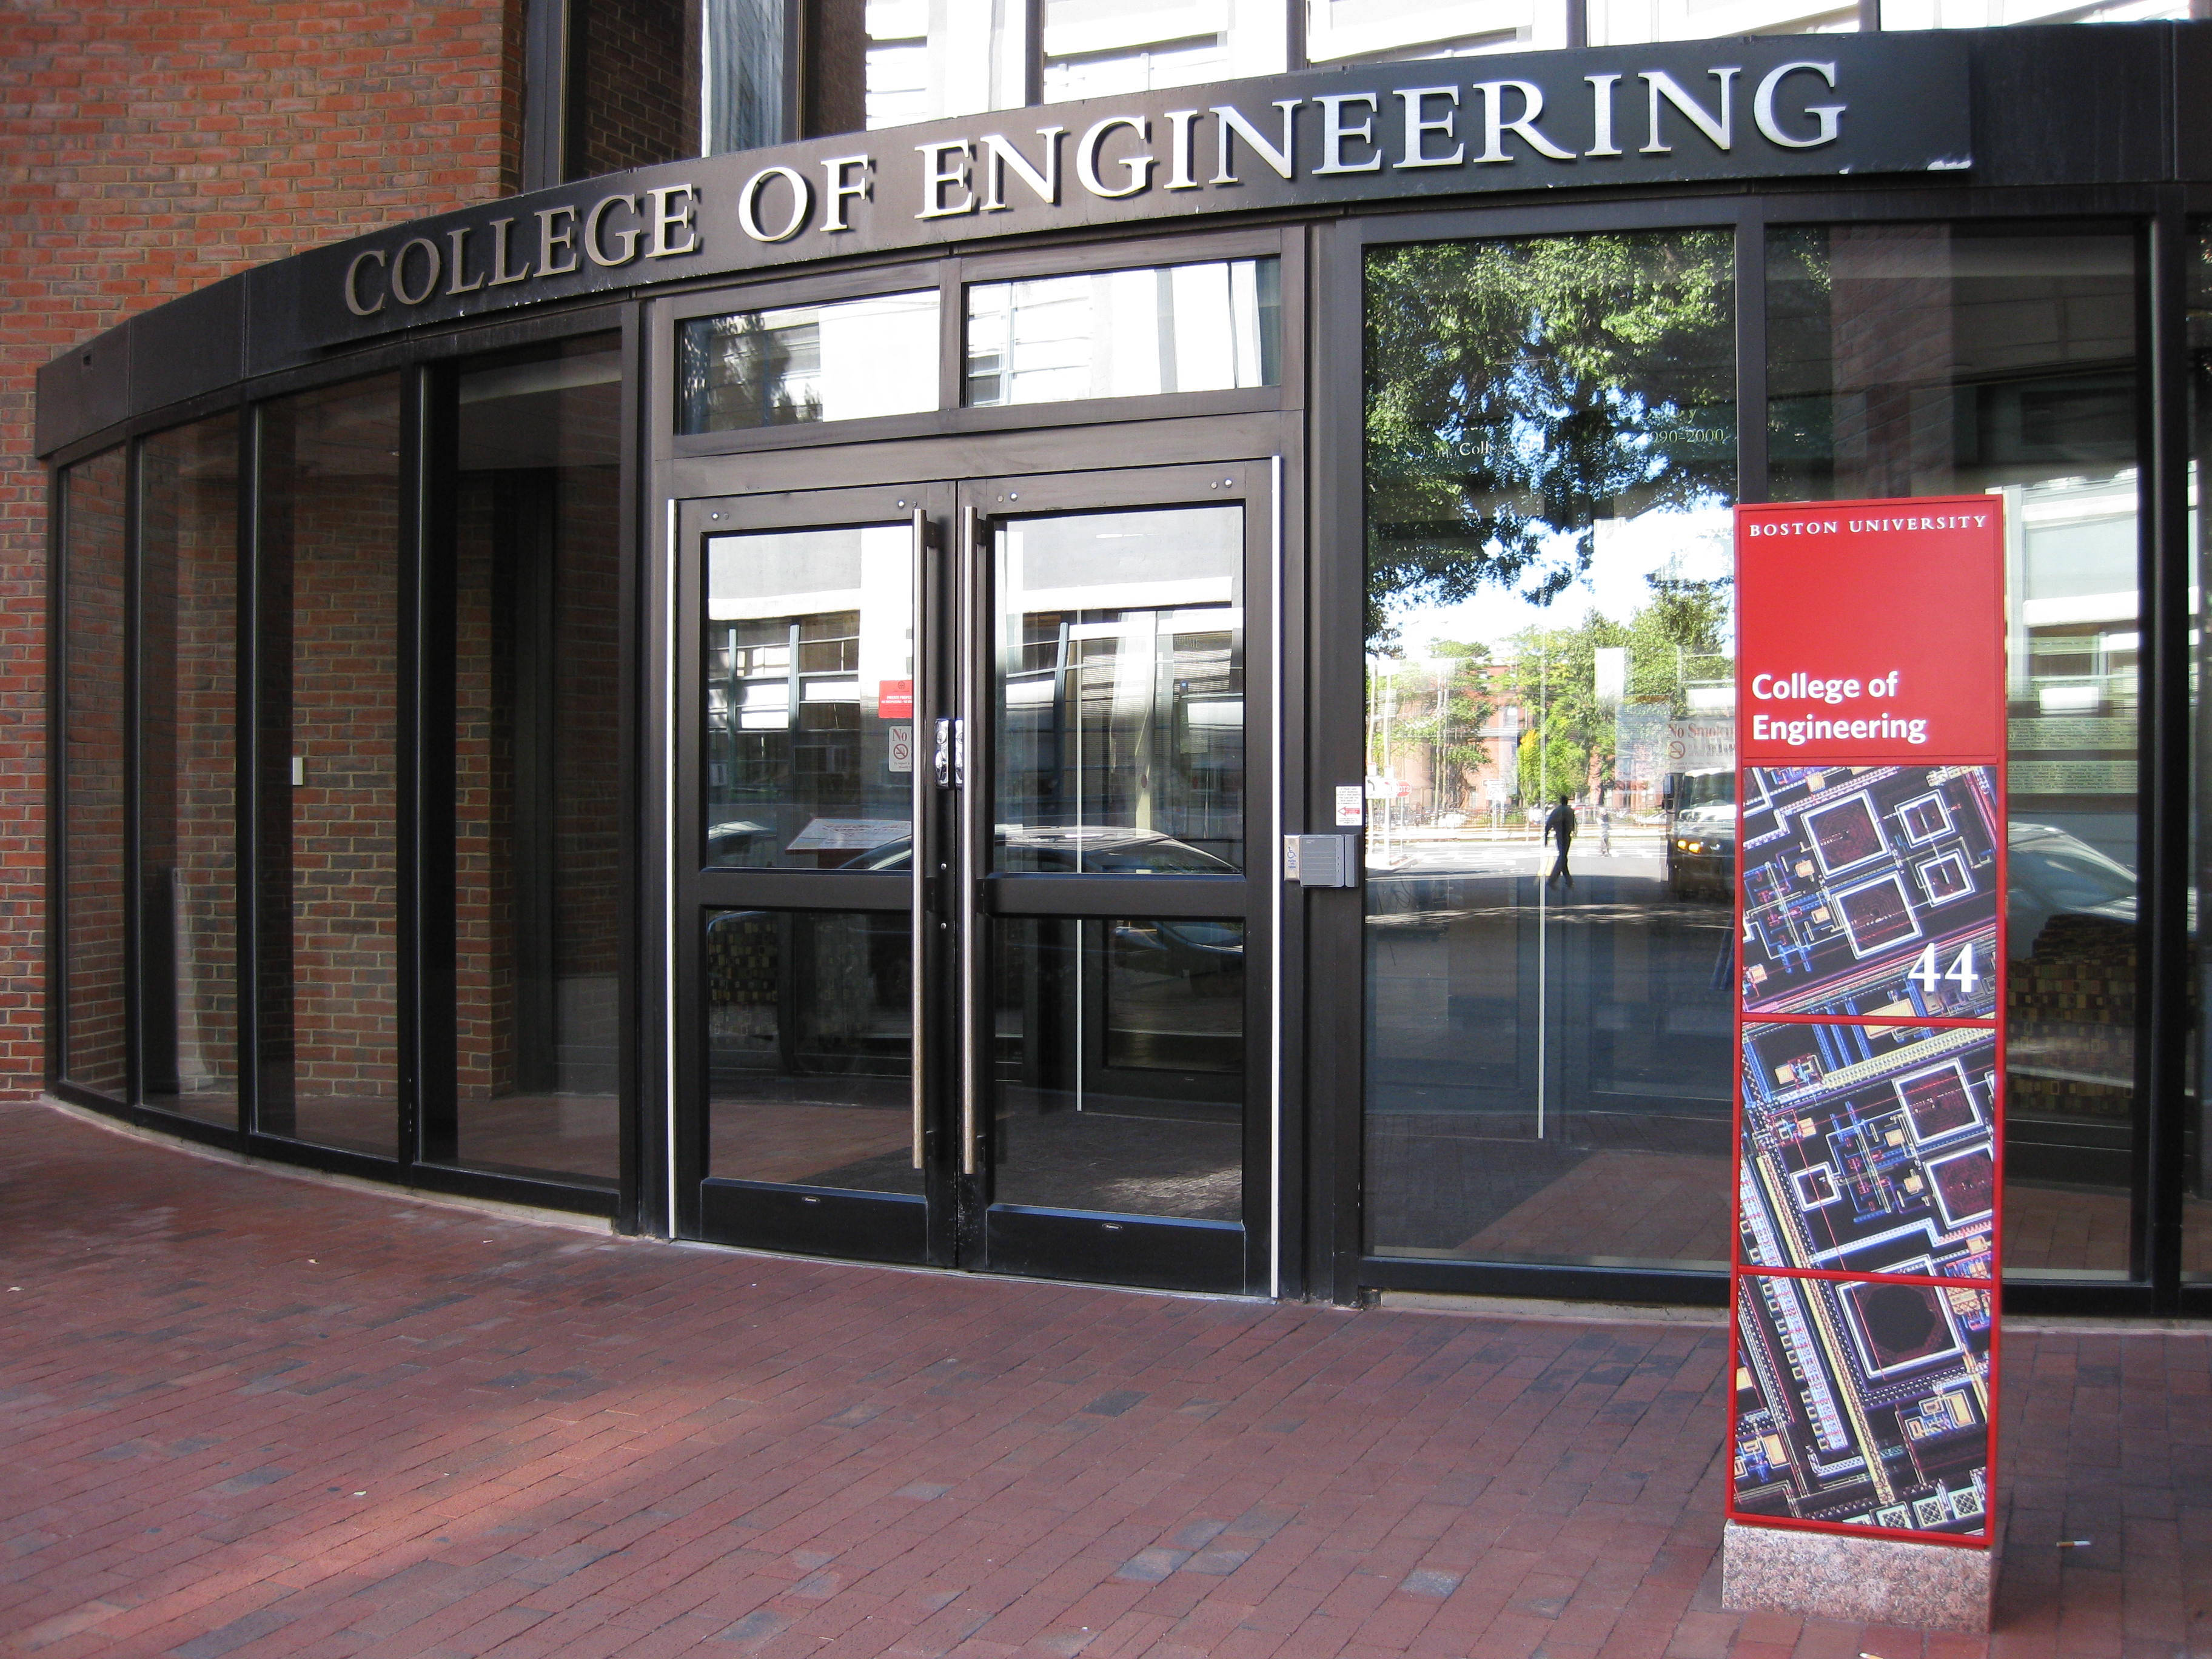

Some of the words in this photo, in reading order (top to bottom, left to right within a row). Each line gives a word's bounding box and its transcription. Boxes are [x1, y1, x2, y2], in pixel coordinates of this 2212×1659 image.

[345, 183, 696, 316] COLLEGE
[738, 153, 869, 243] OF
[914, 61, 1846, 221] ENGINEERING
[1749, 521, 1838, 537] BOSTON
[1849, 515, 1988, 533] UNIVERSITY
[1751, 672, 1860, 704] College
[1868, 671, 1899, 698] of
[892, 729, 908, 742] No
[1752, 712, 1927, 746] Engineering
[1907, 942, 1979, 993] 44
